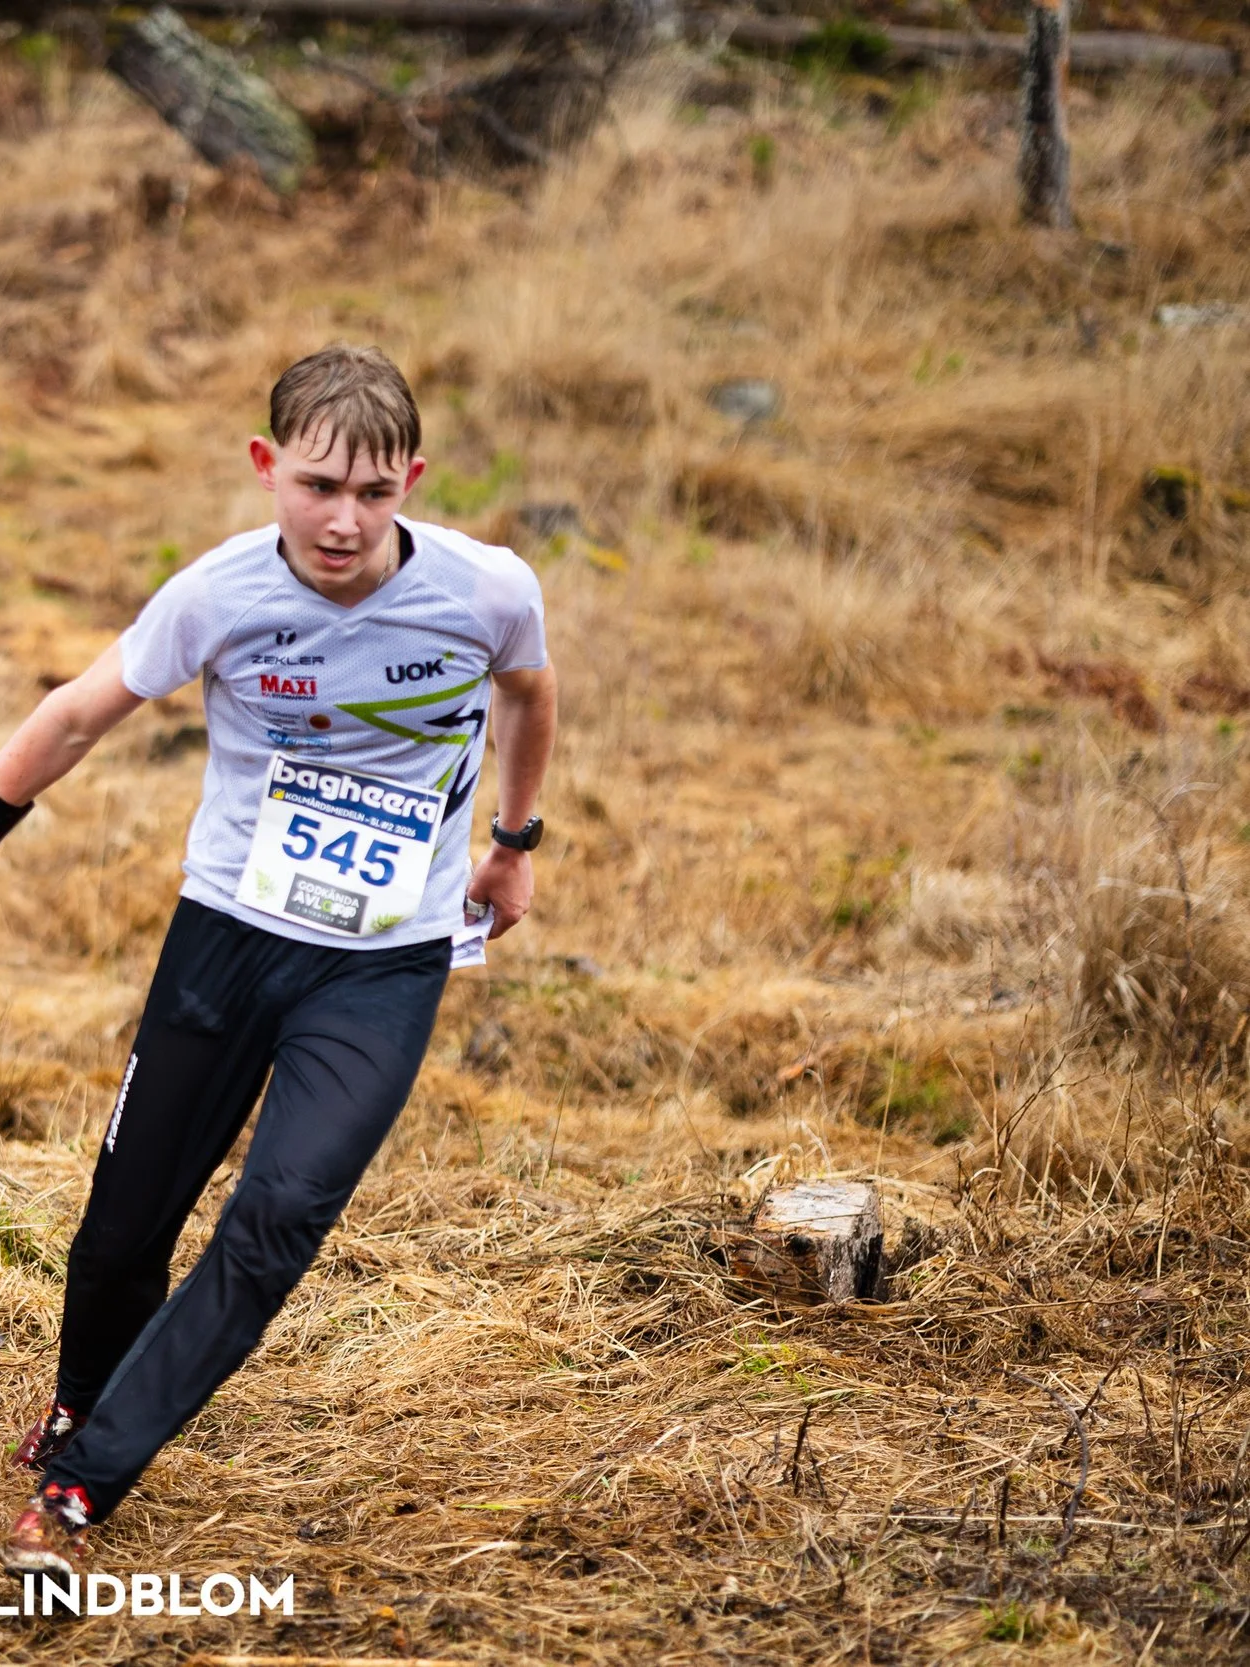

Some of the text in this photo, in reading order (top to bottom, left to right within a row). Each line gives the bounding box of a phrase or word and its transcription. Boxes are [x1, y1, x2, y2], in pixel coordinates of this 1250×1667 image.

[251, 654, 325, 666] ZEKLER
[385, 658, 446, 684] UOK
[260, 674, 317, 695] MAXI
[272, 759, 439, 824] bagheera
[284, 792, 366, 823] KOLMÅRDSMEDELN
[395, 825, 417, 838] 2026
[282, 813, 400, 887] 545
